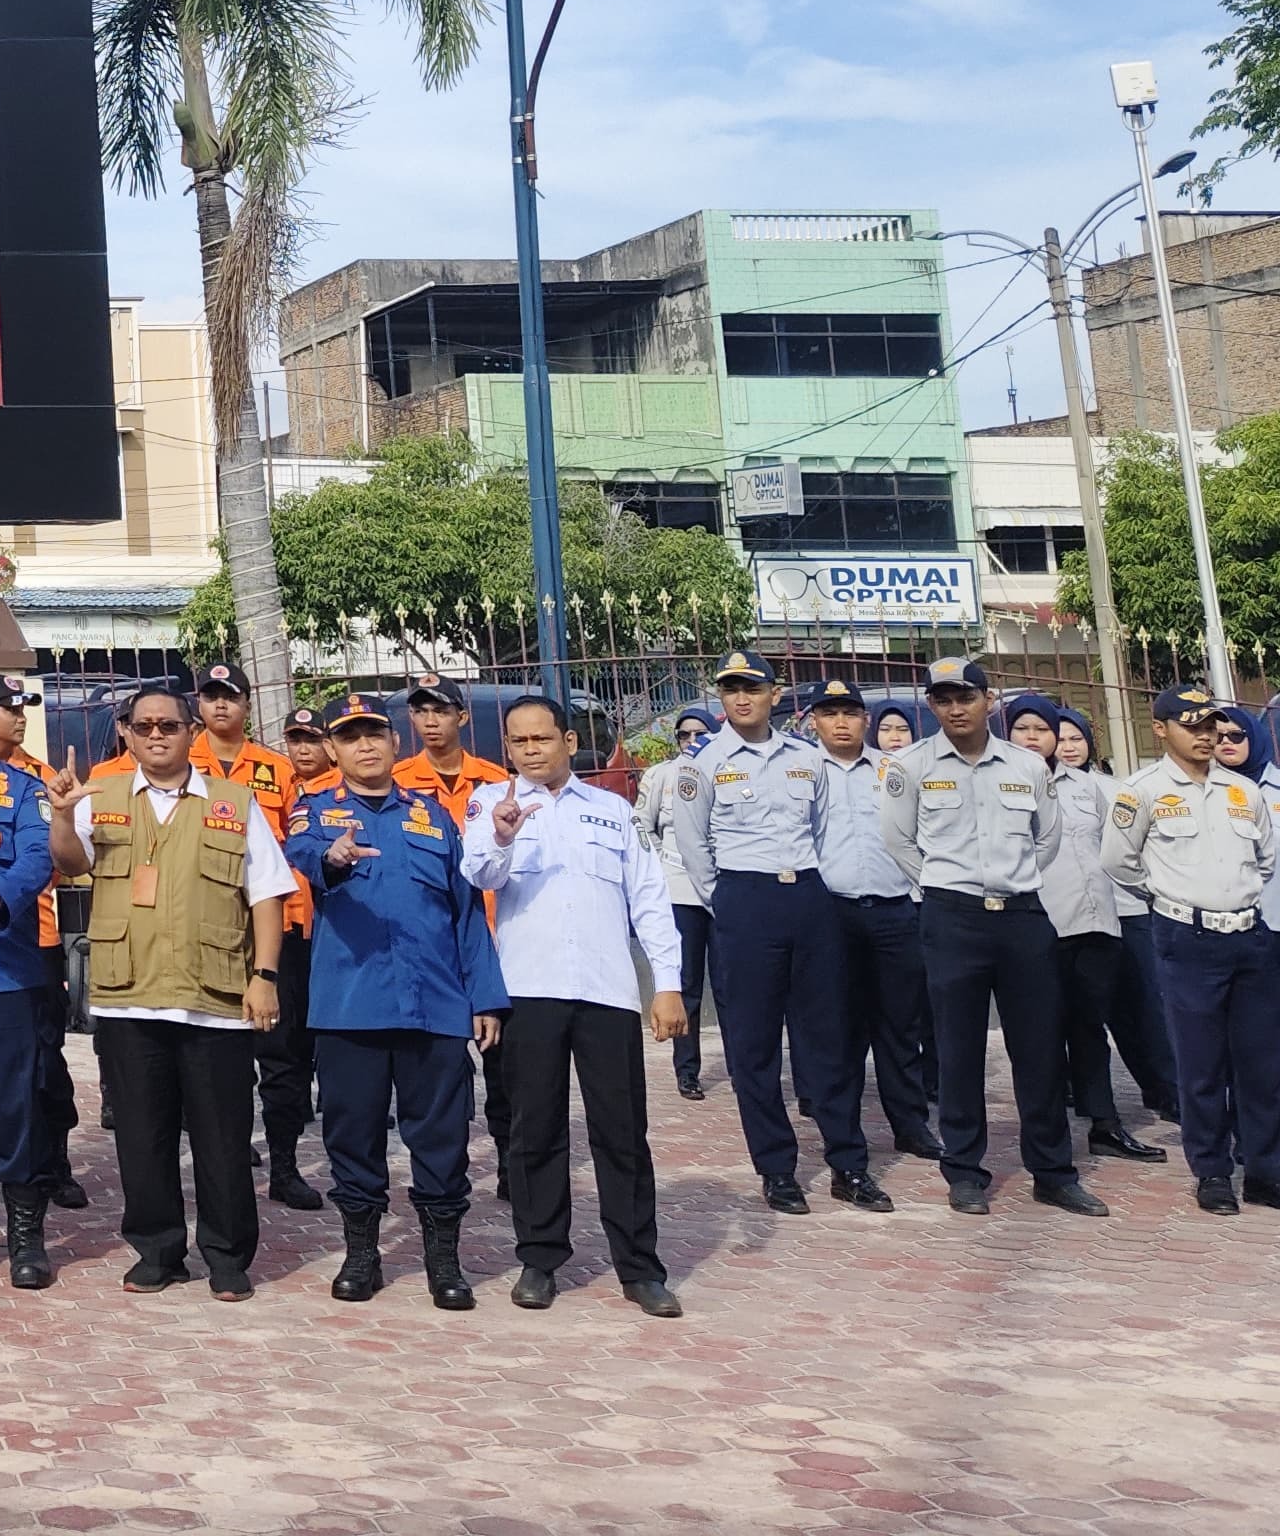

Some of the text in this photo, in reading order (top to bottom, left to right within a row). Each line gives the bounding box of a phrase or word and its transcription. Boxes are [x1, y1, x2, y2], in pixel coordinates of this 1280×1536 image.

[754, 471, 784, 488] DUMAI
[755, 486, 785, 500] OPTICAL
[829, 567, 959, 587] DUMAI
[833, 589, 961, 603] OPTICAL
[51, 633, 78, 641] PANCA
[93, 814, 126, 824] JOKO
[206, 819, 243, 832] BPBD
